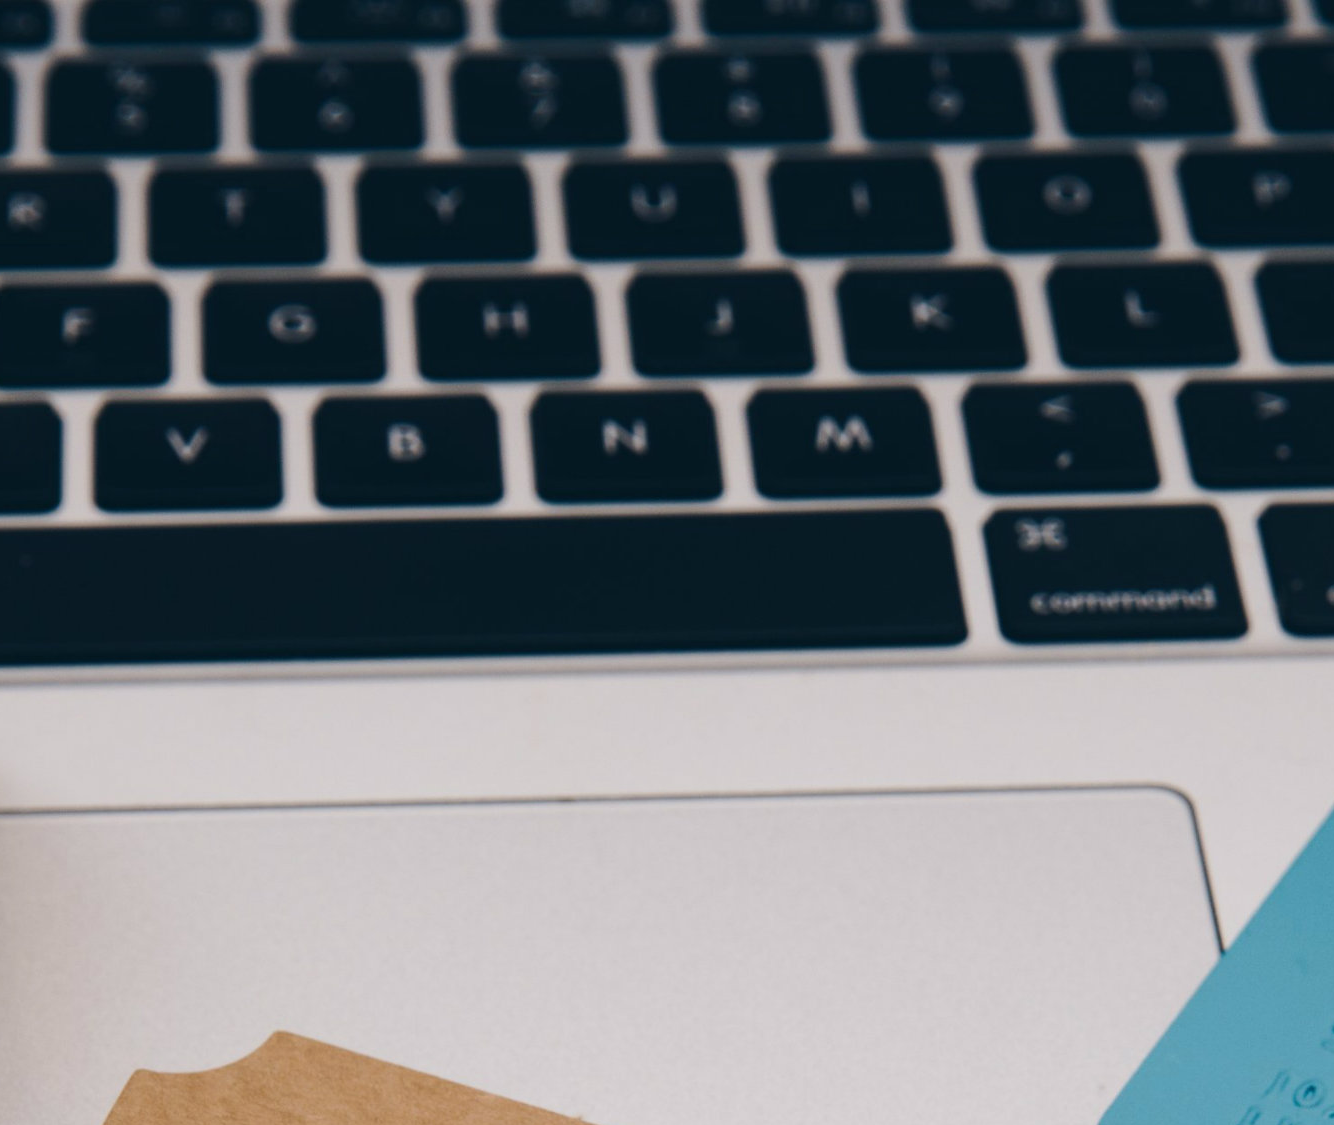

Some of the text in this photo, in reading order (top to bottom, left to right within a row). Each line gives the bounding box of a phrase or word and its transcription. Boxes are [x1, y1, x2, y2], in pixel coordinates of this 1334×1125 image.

[628, 185, 680, 220] U
[61, 307, 95, 343] F
[480, 303, 531, 335] H
[709, 298, 735, 336] J
[910, 293, 952, 328] K
[1122, 289, 1156, 327] L
[165, 428, 208, 464] V
[385, 422, 426, 462] B
[600, 418, 650, 455] N
[813, 414, 874, 452] M
[1028, 583, 1219, 615] command
